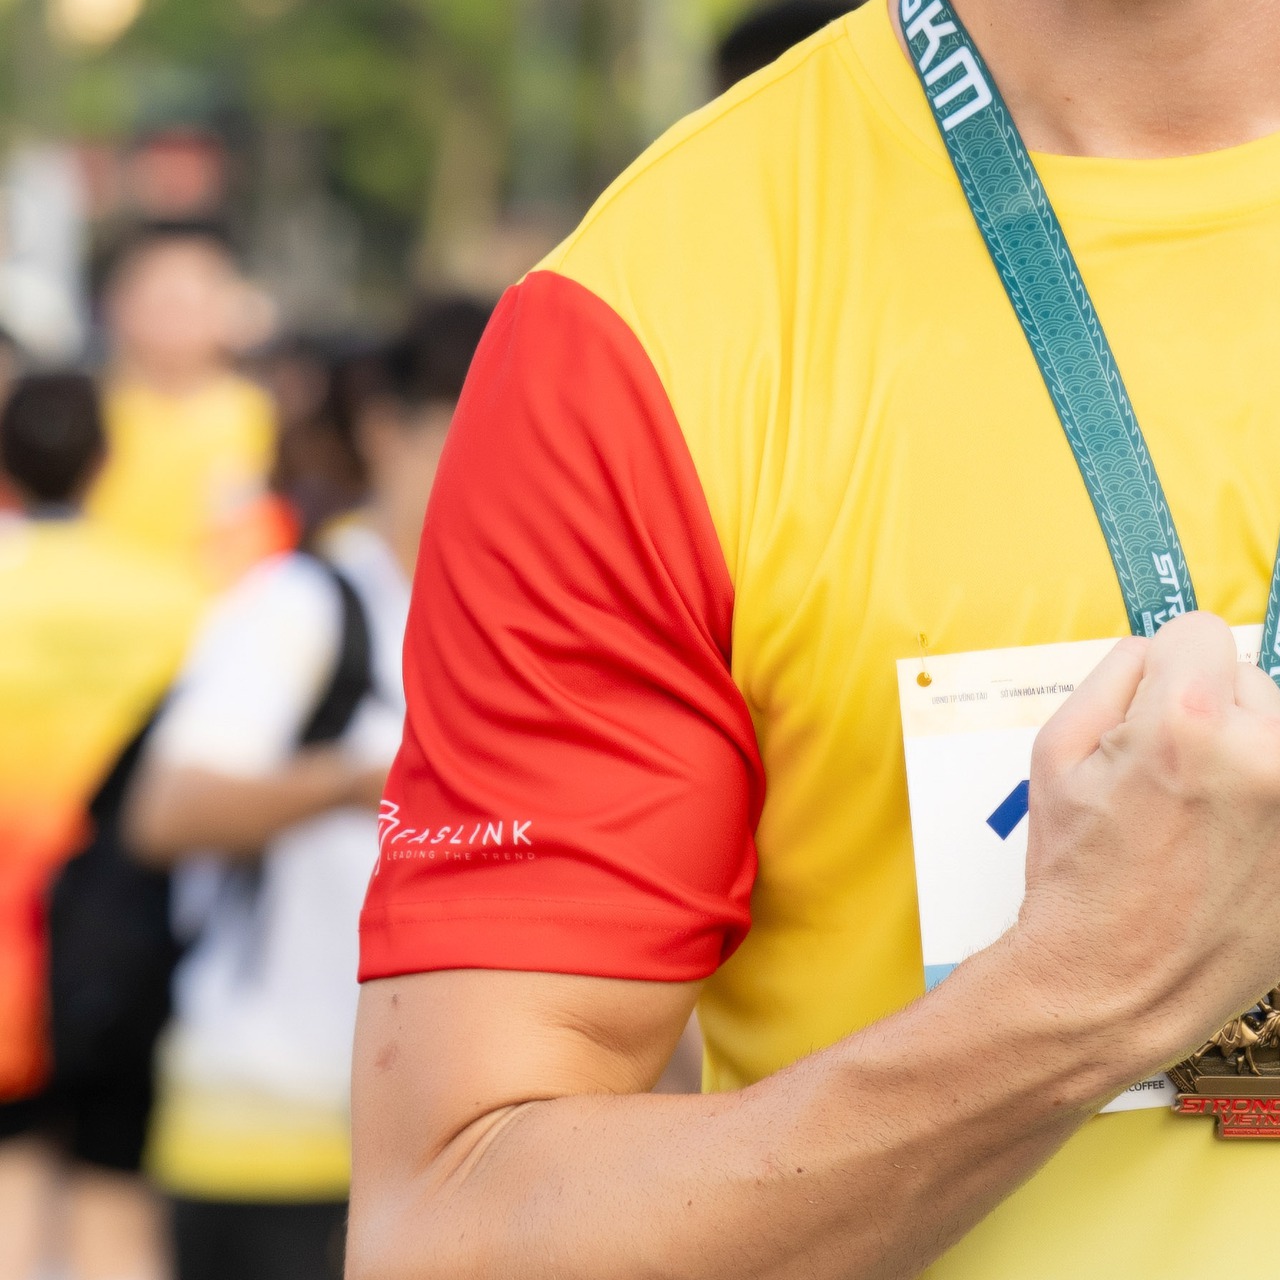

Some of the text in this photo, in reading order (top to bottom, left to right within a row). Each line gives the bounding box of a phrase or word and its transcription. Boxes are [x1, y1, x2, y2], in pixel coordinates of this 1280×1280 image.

[387, 850, 536, 861] LEADING THE TREND
